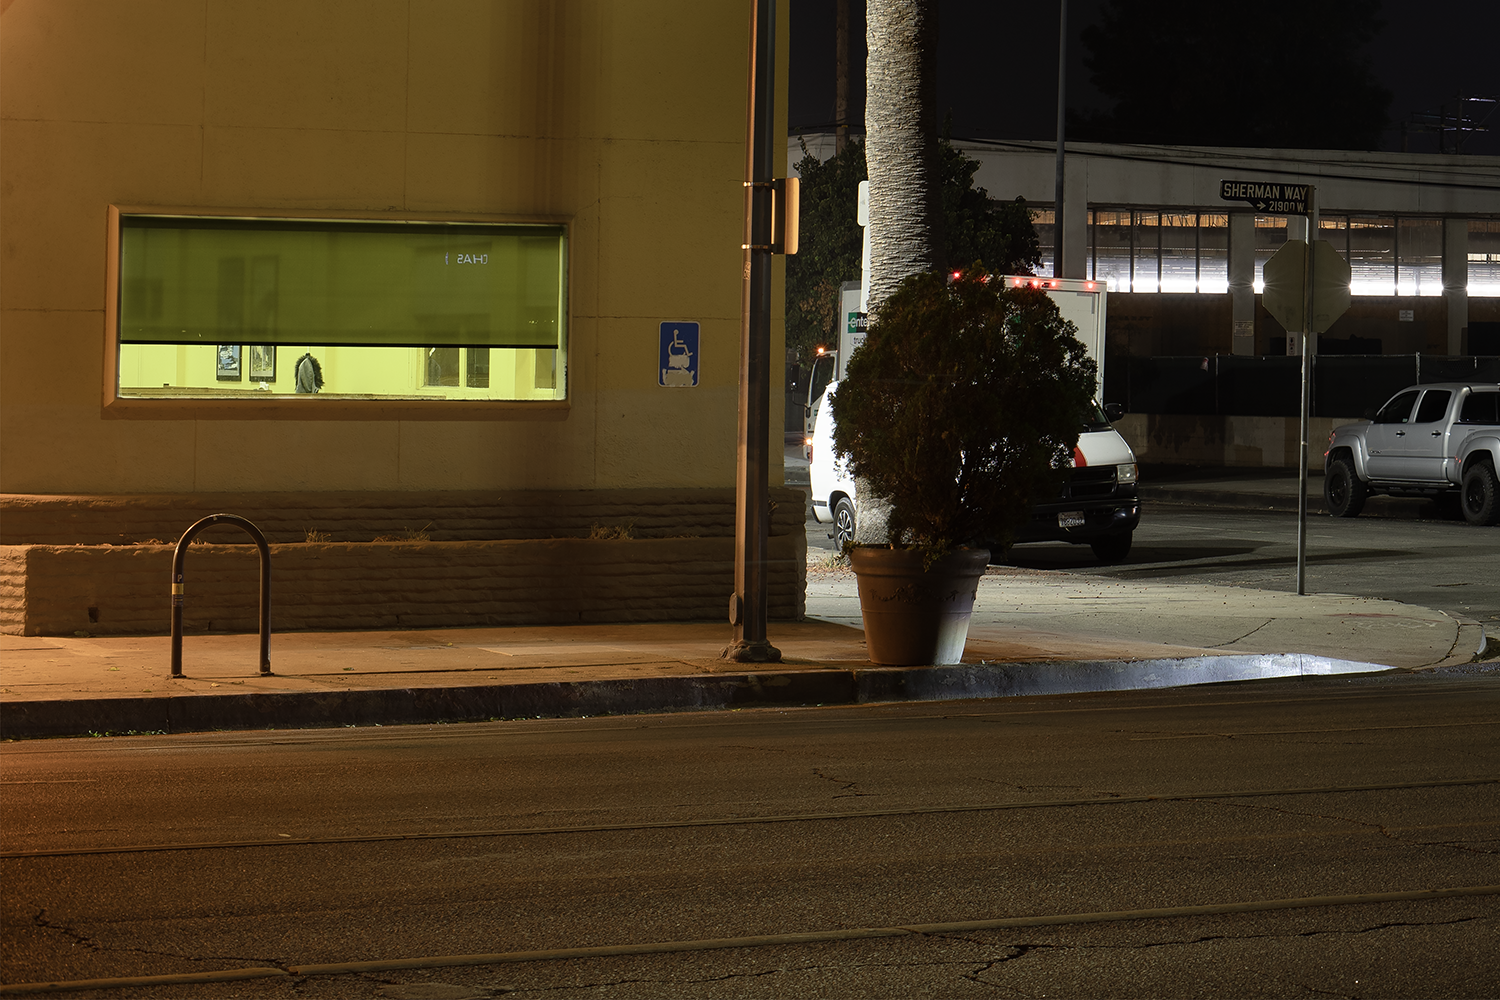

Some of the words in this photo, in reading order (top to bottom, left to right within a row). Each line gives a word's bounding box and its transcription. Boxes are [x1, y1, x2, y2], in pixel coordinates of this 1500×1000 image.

[1224, 183, 1280, 199] SHERMAN
[1284, 186, 1307, 200] WAY
[1268, 201, 1296, 212] 21900
